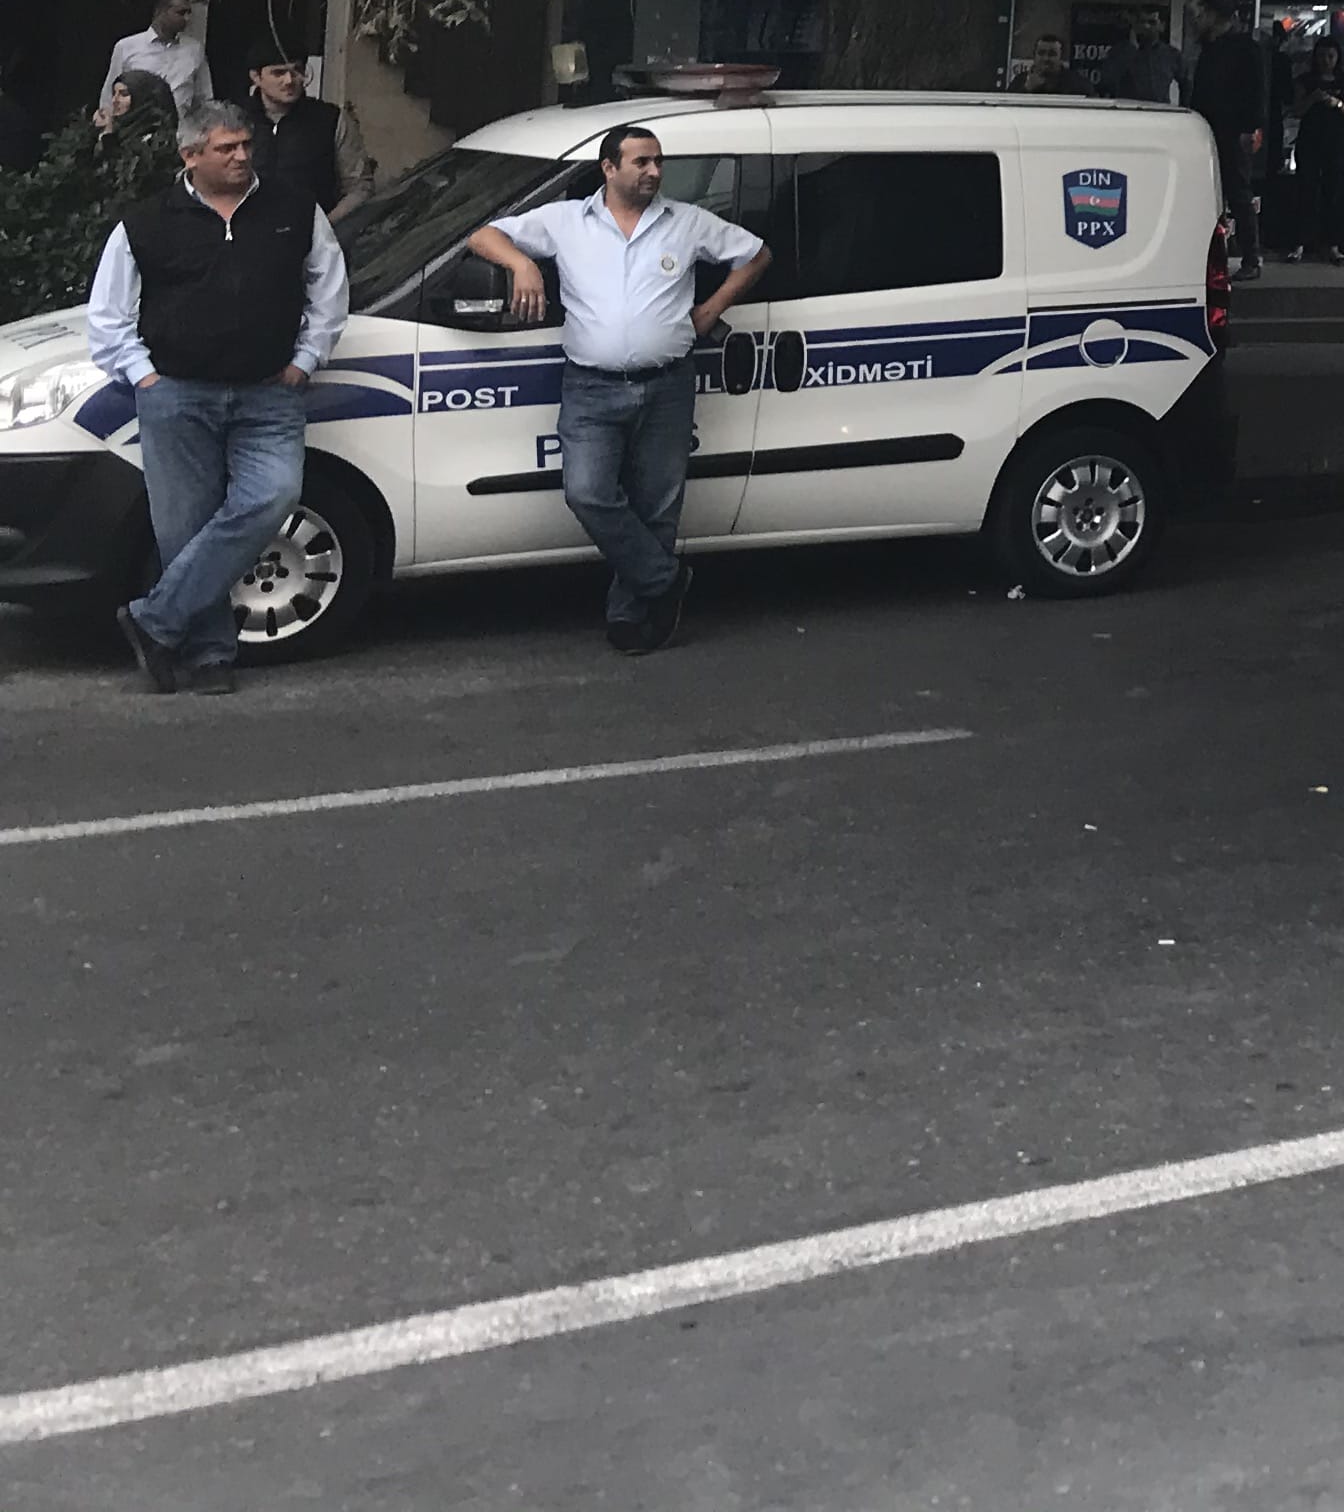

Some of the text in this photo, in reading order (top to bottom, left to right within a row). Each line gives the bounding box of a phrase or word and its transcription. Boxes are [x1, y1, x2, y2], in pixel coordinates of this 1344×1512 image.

[1079, 170, 1111, 186] DİN
[1077, 221, 1115, 236] PPX
[422, 354, 933, 412] POST XİDMƏTİ
